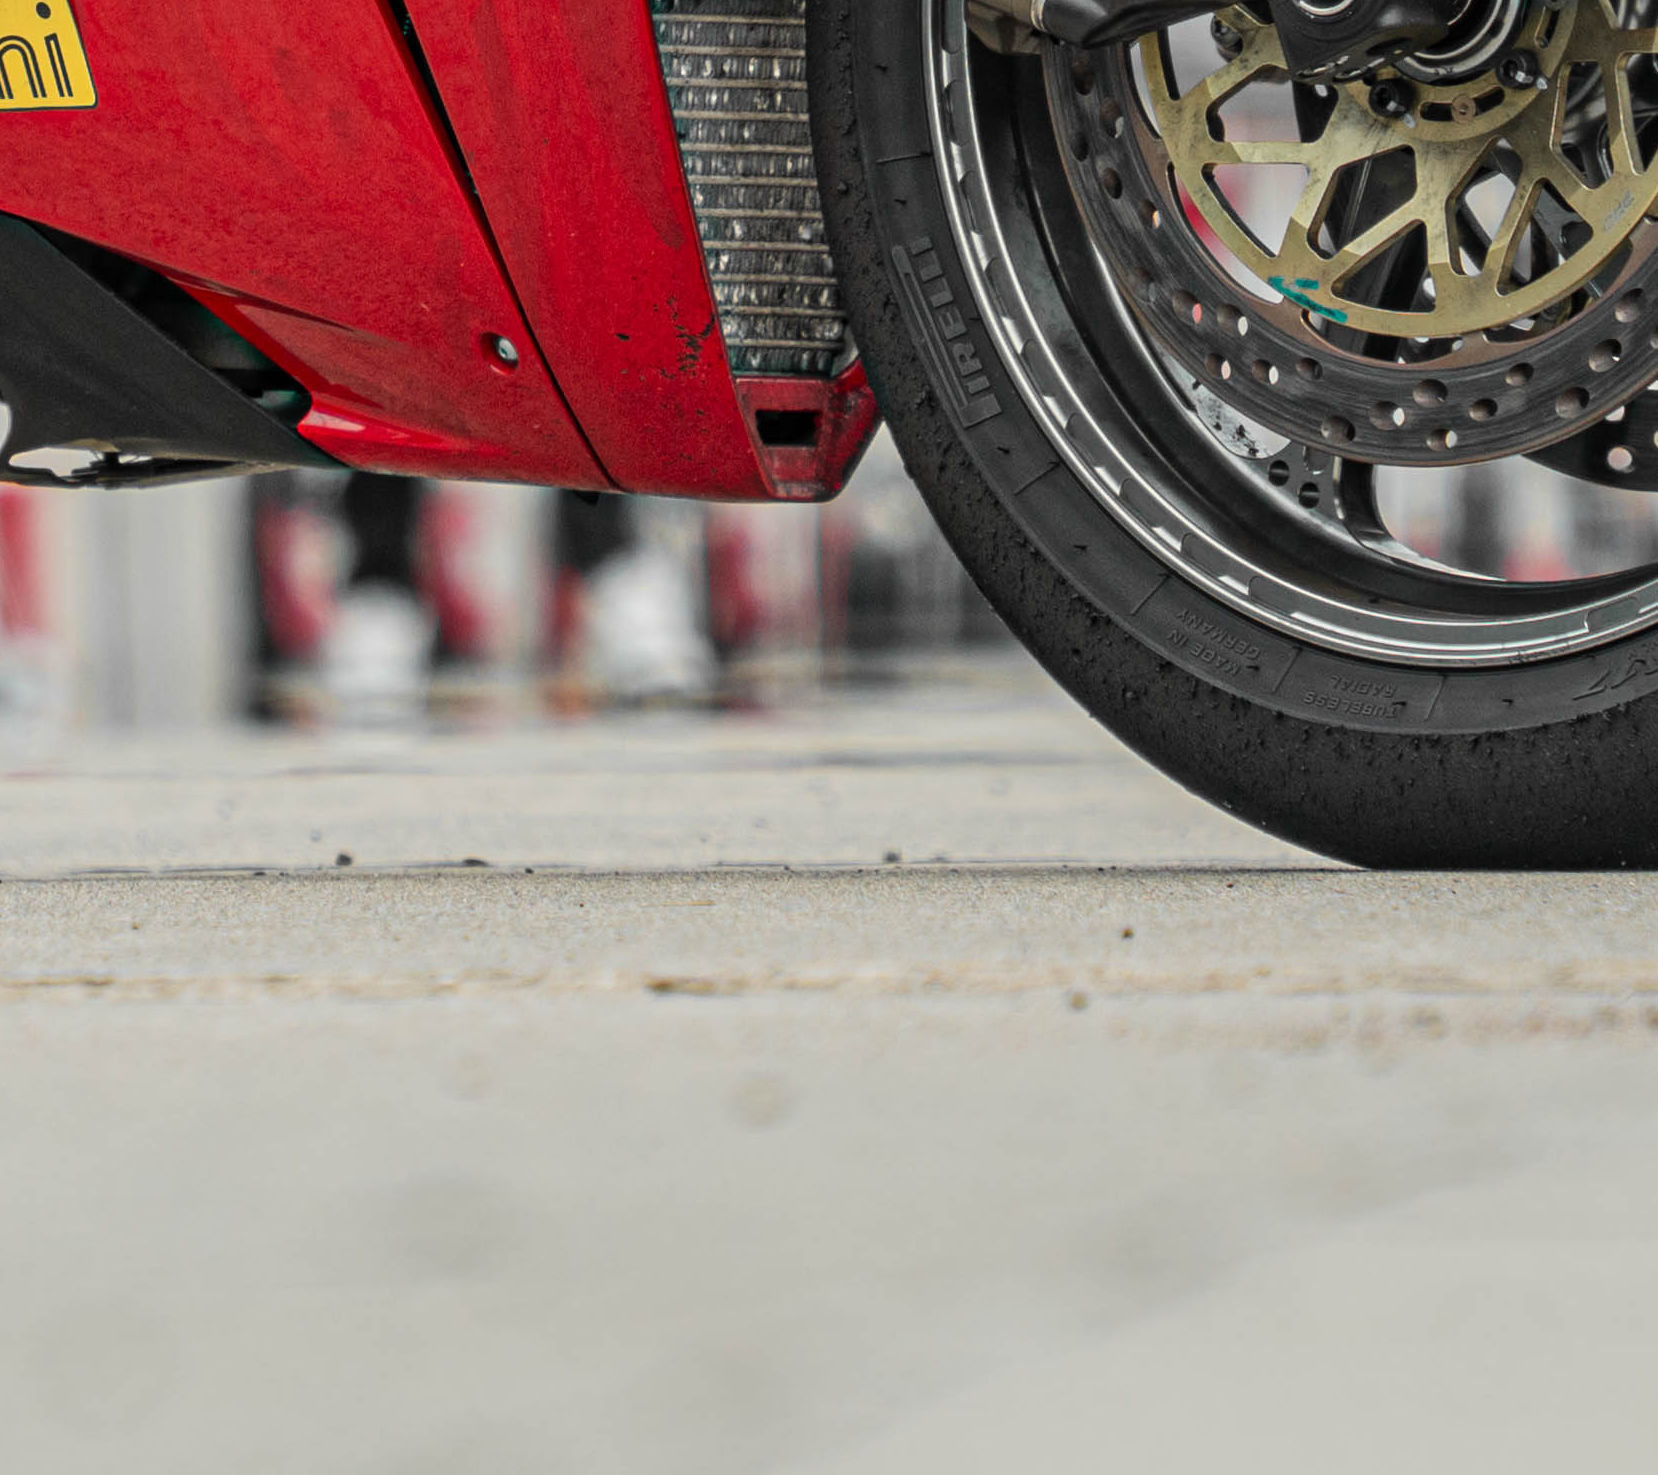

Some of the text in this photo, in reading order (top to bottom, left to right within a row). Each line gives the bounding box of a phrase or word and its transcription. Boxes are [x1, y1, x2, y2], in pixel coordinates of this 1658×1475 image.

[891, 234, 1002, 431] PIRELLI
[1168, 629, 1241, 675] MADE IN
[1177, 611, 1261, 659] GERMANY
[1303, 691, 1398, 720] TUBELESS
[1330, 674, 1397, 699] RADIAL
